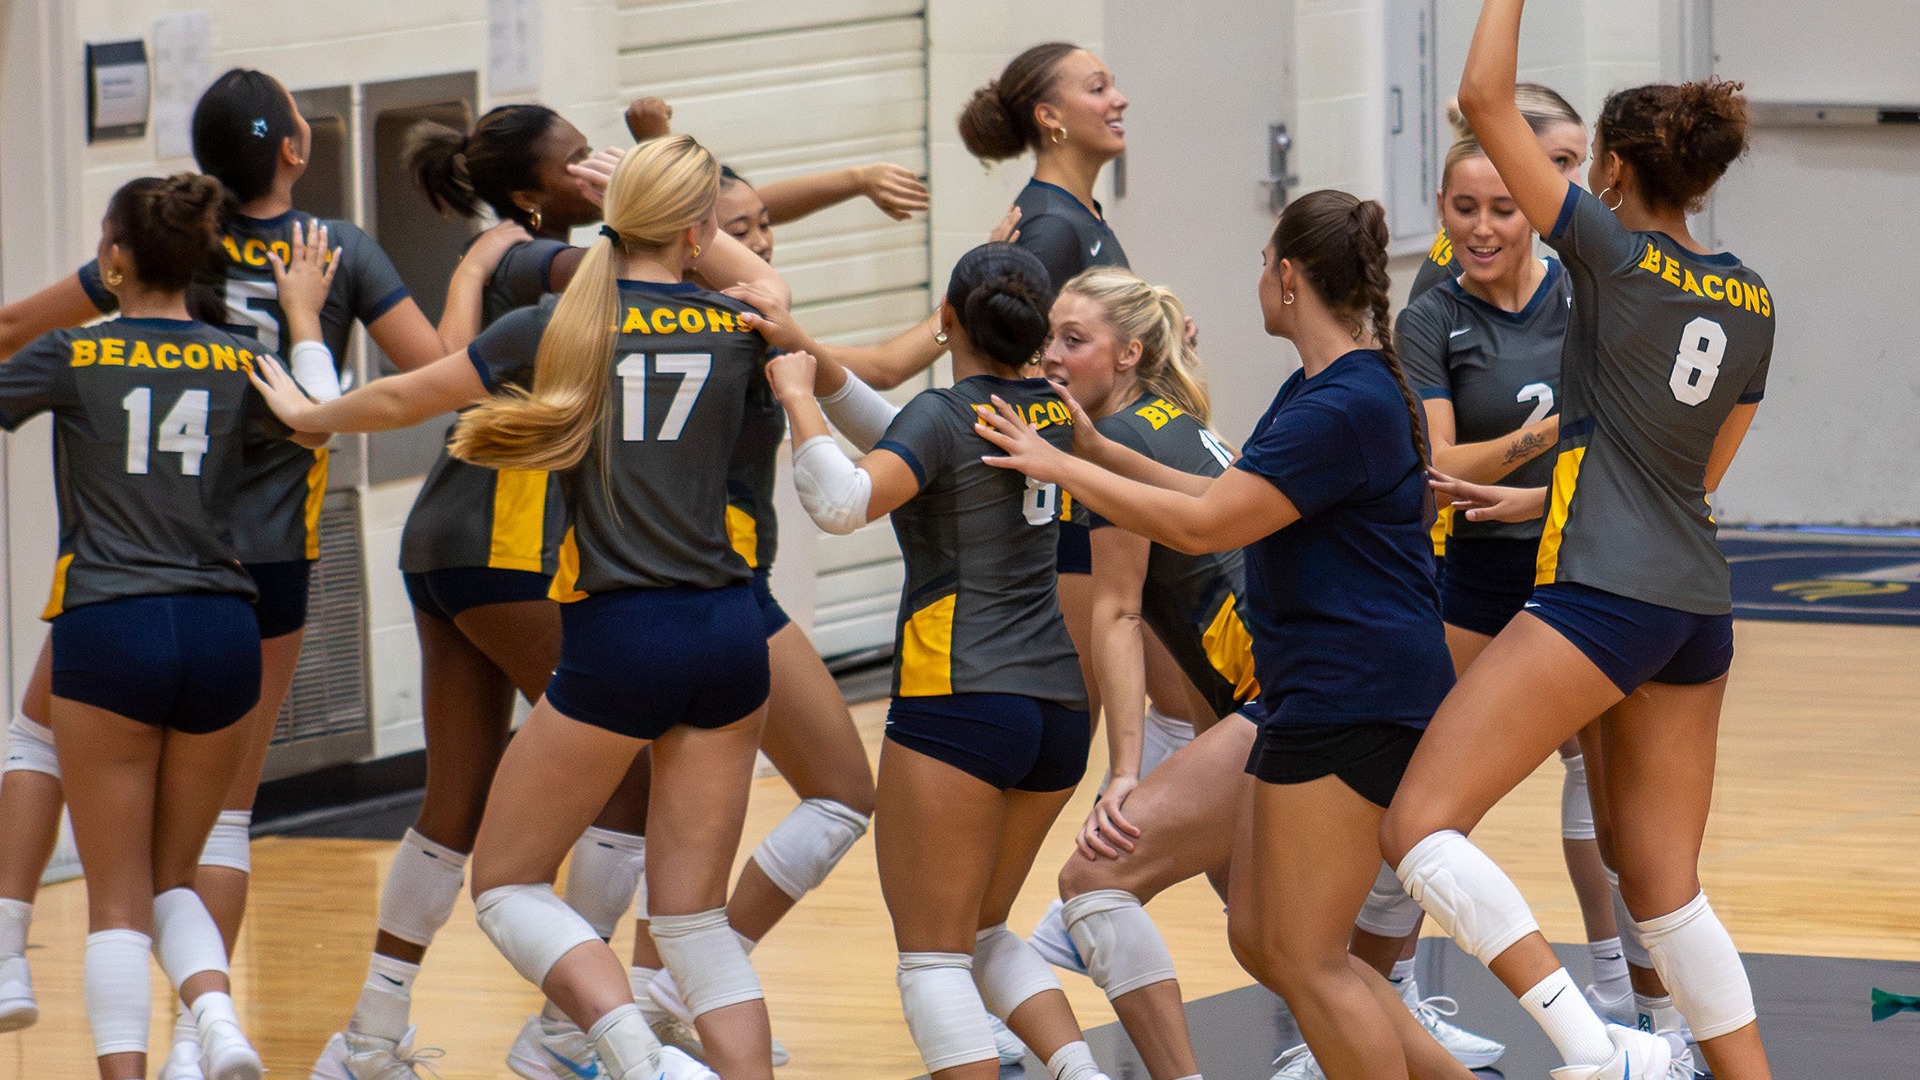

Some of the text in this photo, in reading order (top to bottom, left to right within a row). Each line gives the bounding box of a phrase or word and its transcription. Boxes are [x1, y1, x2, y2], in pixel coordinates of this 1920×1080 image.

[226, 278, 280, 352] 5
[1639, 243, 1771, 317] BEACONS
[70, 338, 254, 373] BEACONS
[1669, 316, 1728, 407] 8
[122, 387, 210, 476] 14
[616, 353, 713, 441] 17
[1516, 382, 1555, 430] 2
